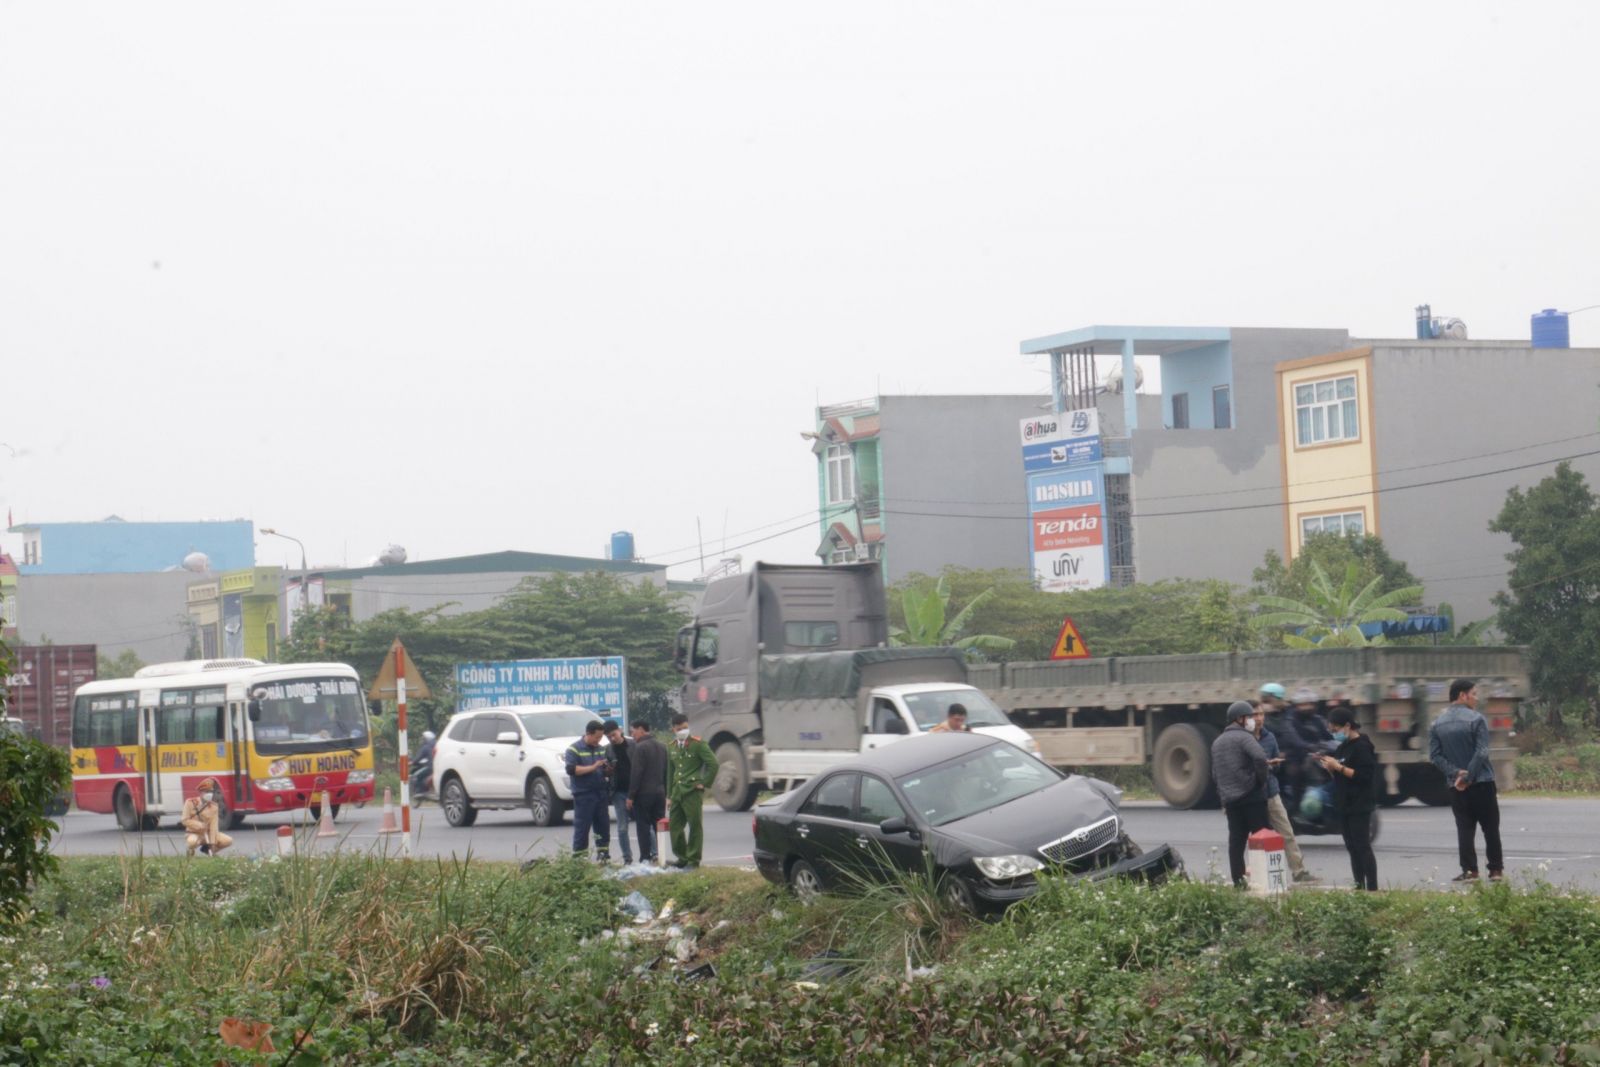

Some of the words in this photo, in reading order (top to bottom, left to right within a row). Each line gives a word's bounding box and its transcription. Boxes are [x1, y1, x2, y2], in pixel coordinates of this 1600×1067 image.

[461, 666, 496, 684] CÔNG
[500, 668, 513, 683] TY
[517, 666, 550, 682] TNHH
[289, 758, 312, 774] HUY
